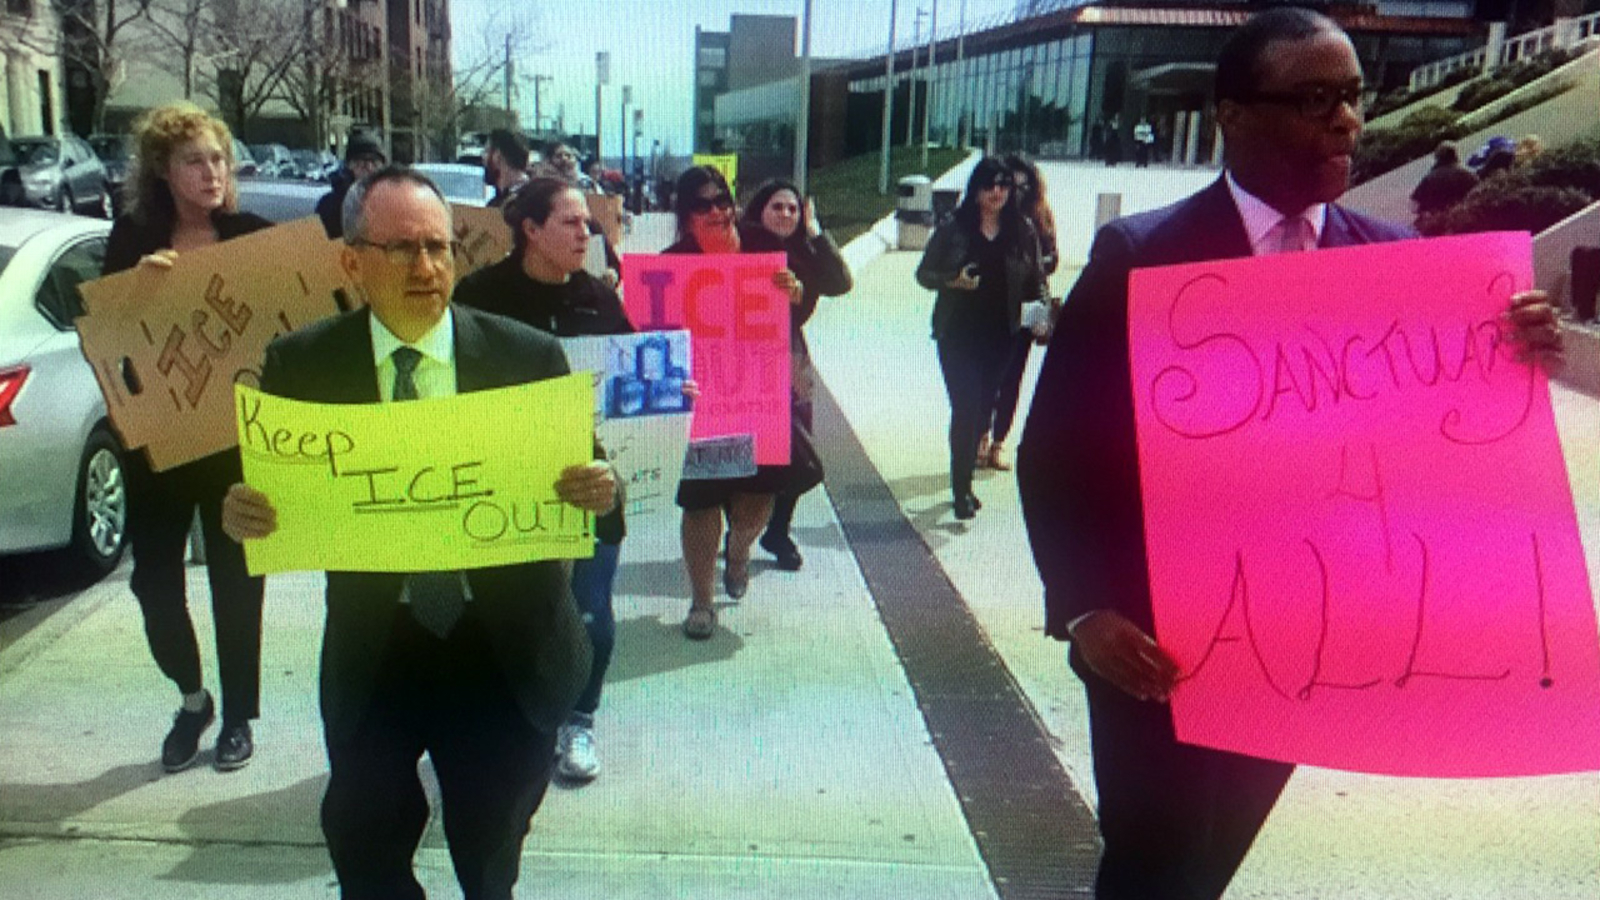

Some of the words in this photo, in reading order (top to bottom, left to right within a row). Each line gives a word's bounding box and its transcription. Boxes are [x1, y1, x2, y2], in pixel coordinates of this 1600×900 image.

[156, 273, 253, 409] ICE
[640, 266, 780, 340] ICE
[240, 394, 354, 477] Keep
[341, 460, 494, 506] ICE
[1324, 444, 1392, 574] 4
[1176, 531, 1553, 701] ALL!
